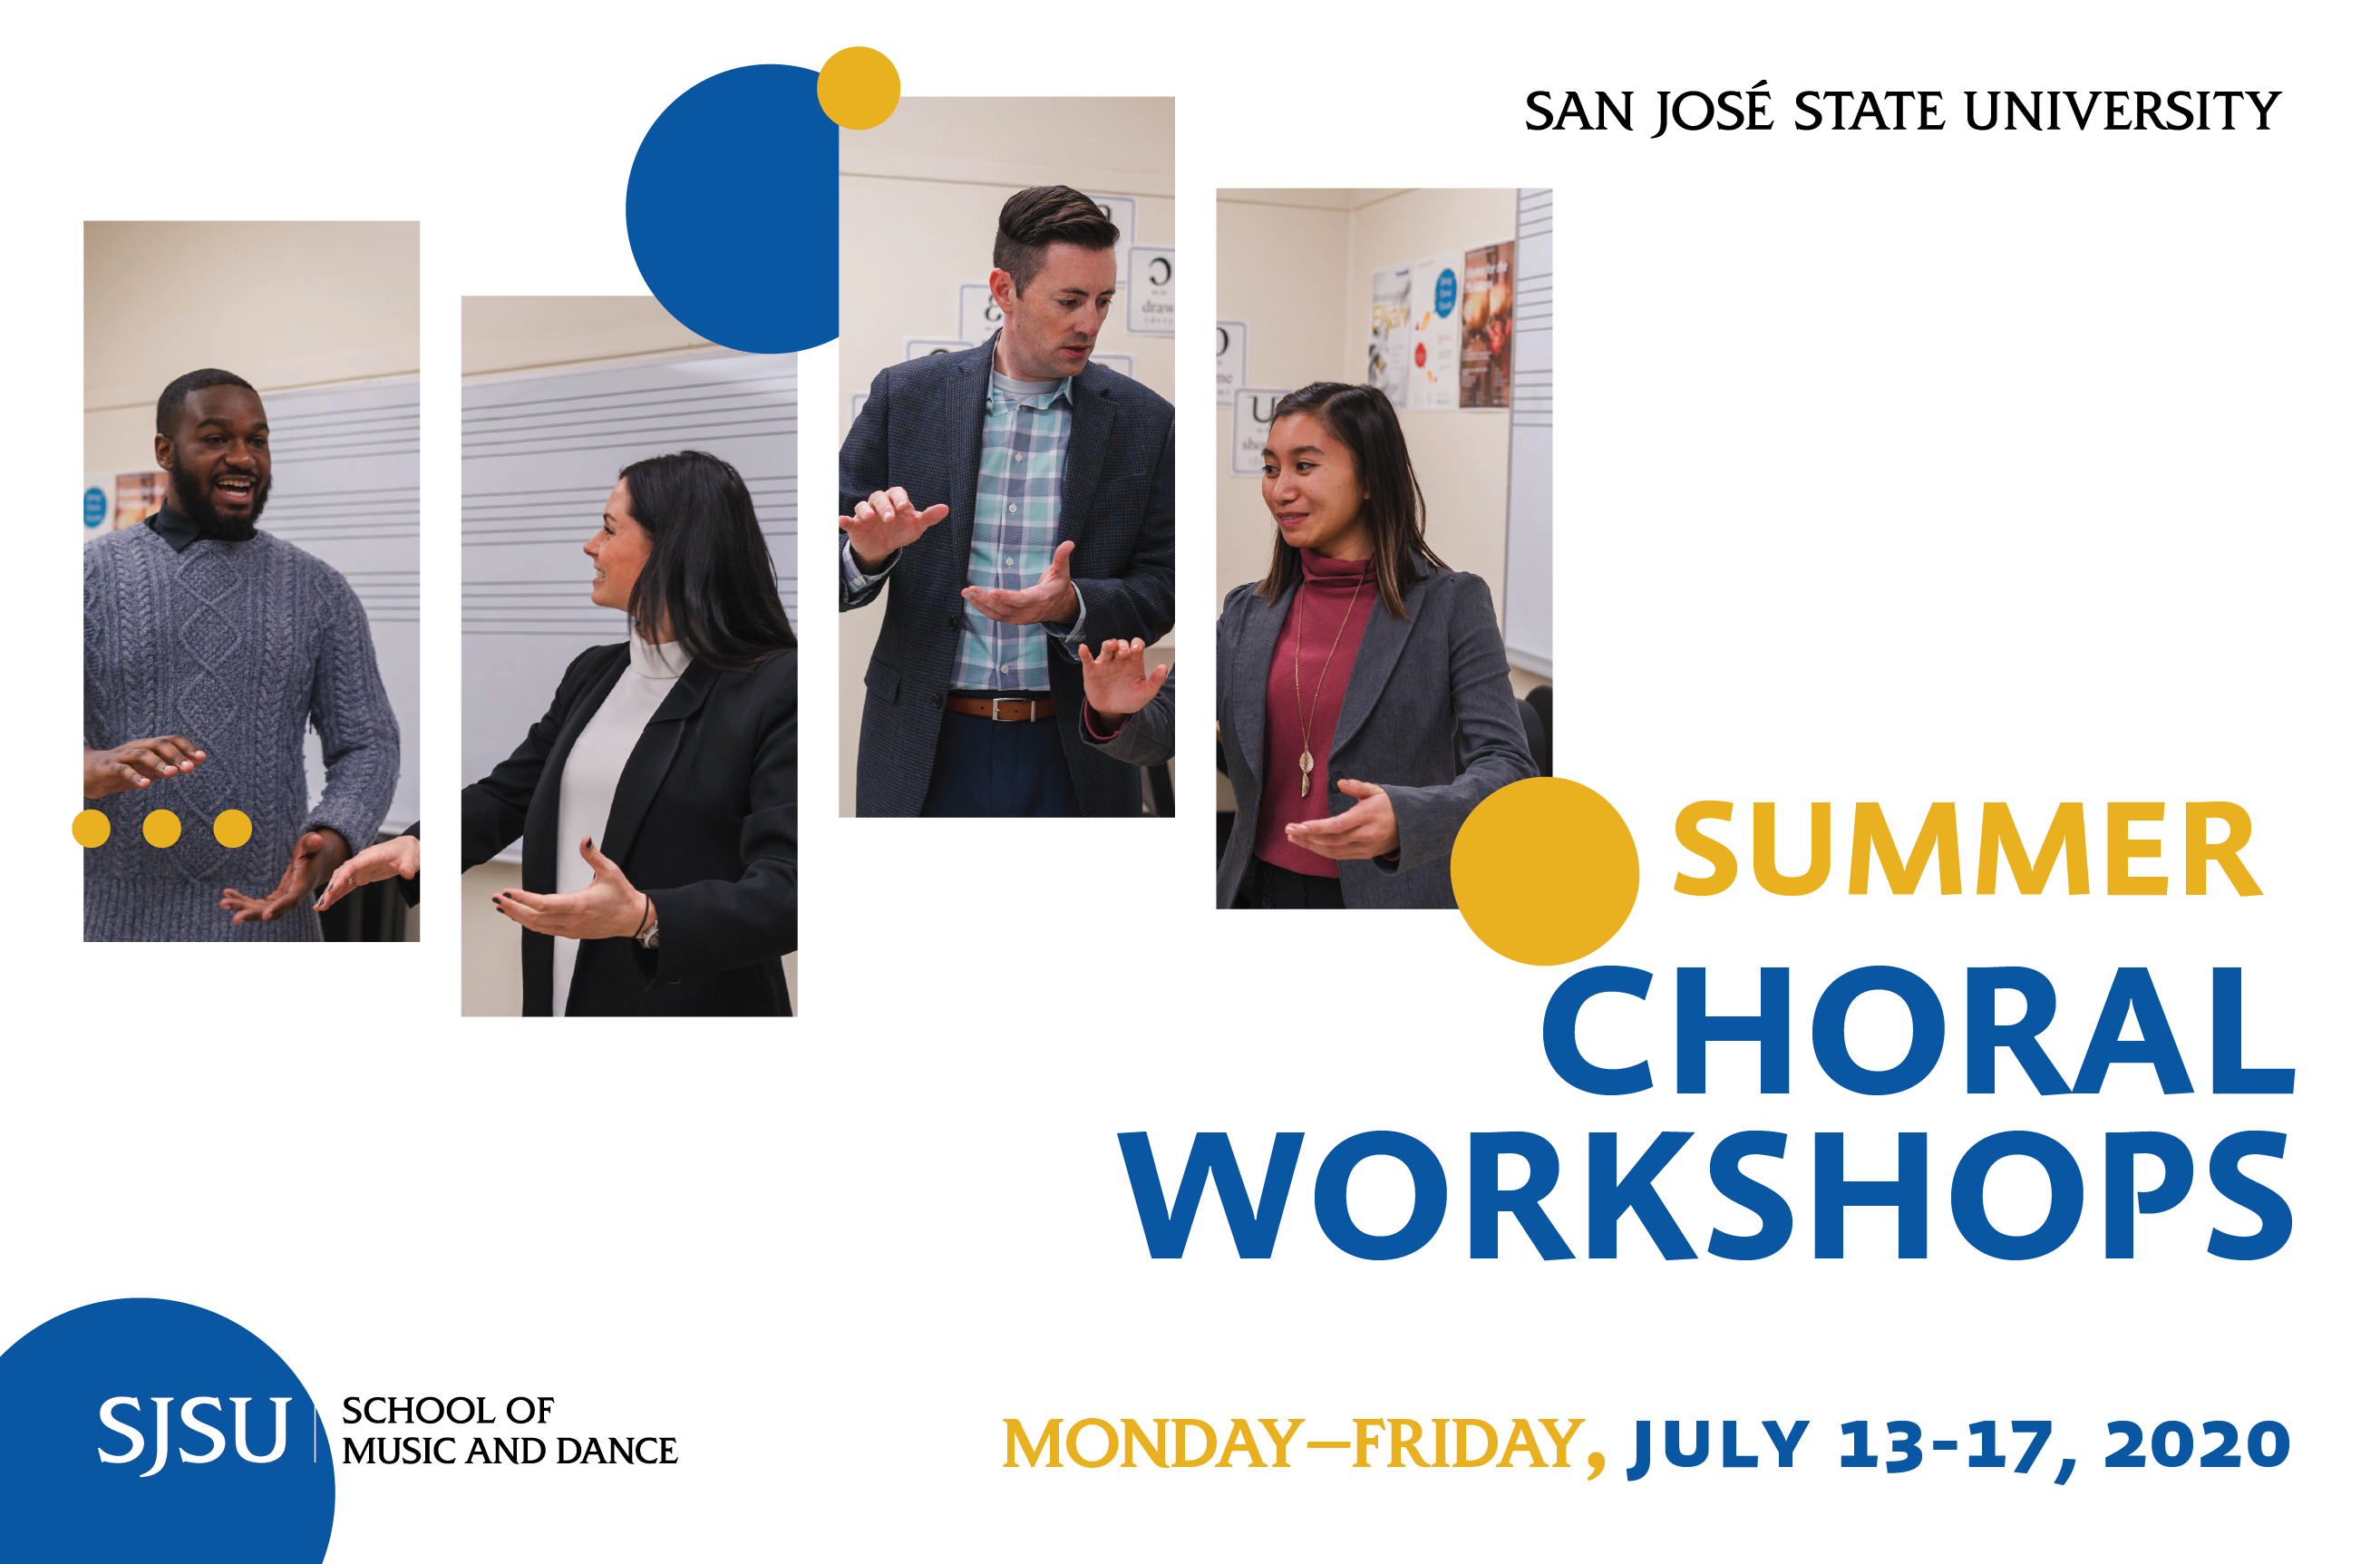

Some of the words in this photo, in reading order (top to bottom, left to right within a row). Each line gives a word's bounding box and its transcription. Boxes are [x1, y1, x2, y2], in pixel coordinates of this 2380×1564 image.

[1526, 91, 1634, 131] SAN
[1650, 80, 1774, 139] JOSÉ
[1795, 91, 1946, 131] STATE
[1964, 91, 2282, 131] UNIVERSITY
[1674, 801, 2264, 897] SUMMER
[1543, 966, 2296, 1095] CHORAL
[1117, 1131, 2292, 1260] WORKSHOPS
[98, 1396, 292, 1477] SJSU
[343, 1397, 496, 1423] SCHOOL
[507, 1397, 555, 1423] OF
[343, 1437, 456, 1464] MUSIC
[464, 1438, 546, 1464] AND
[557, 1437, 678, 1464] DANCE
[1627, 1421, 1810, 1481] JULY
[1841, 1421, 2075, 1485] 13-17,
[2105, 1421, 2289, 1467] 2020
